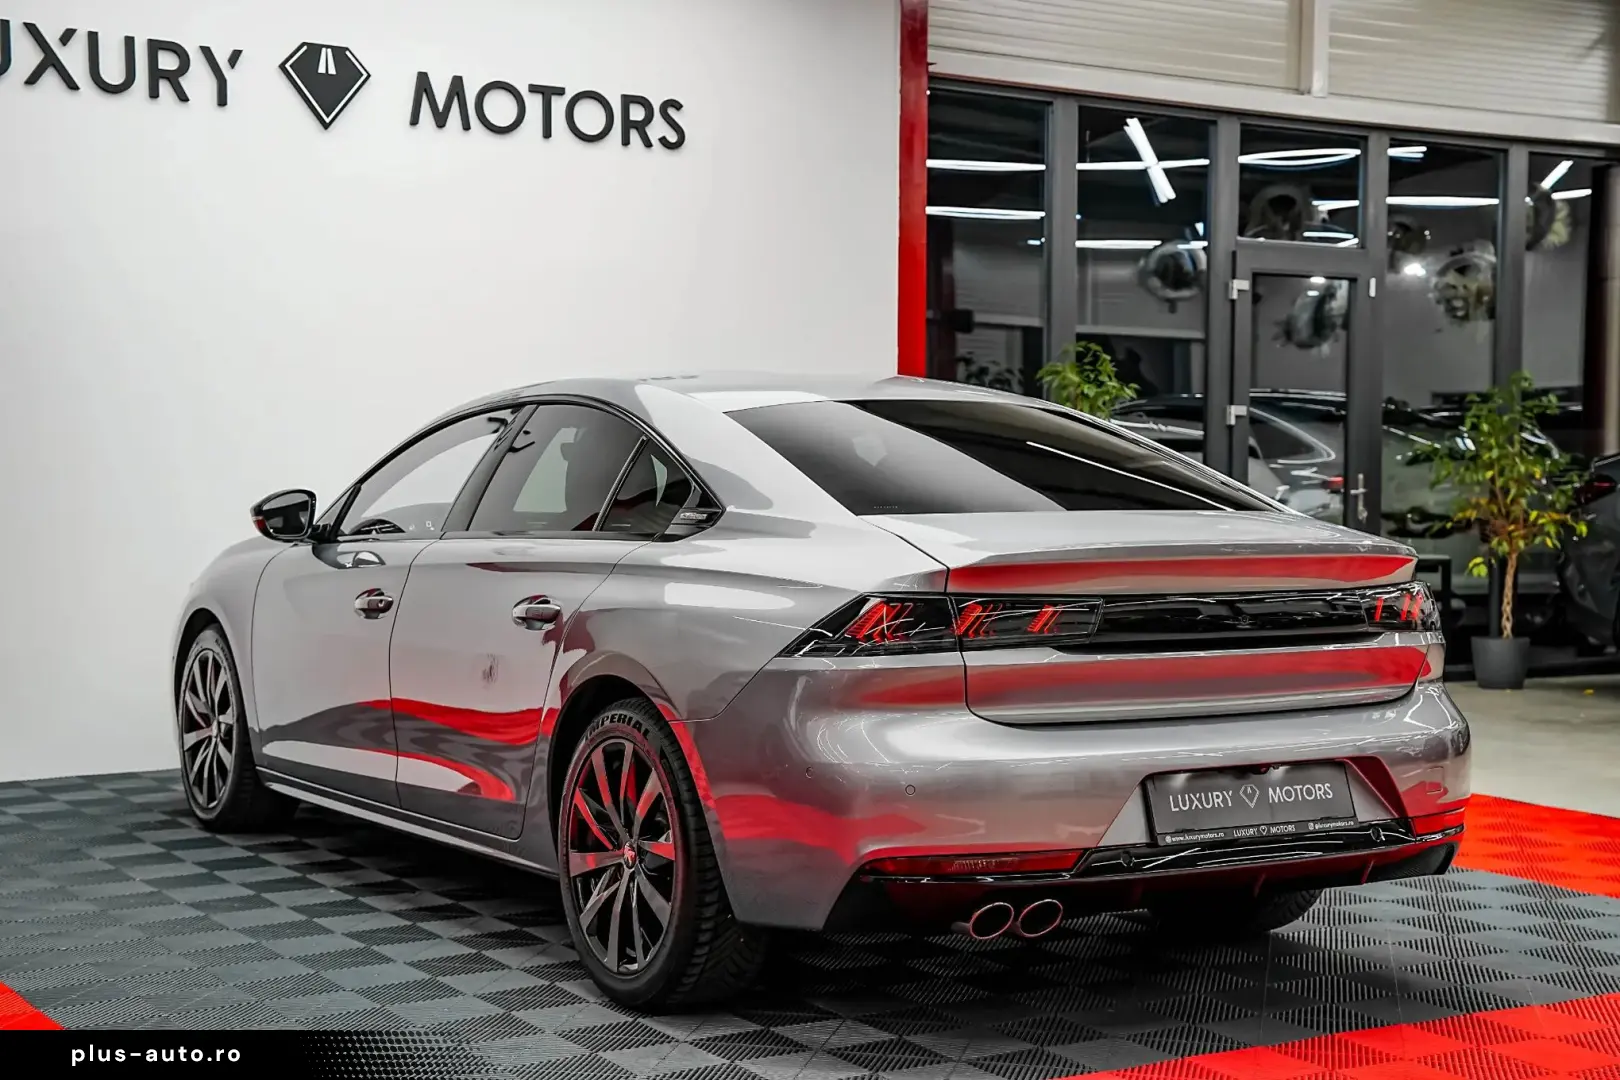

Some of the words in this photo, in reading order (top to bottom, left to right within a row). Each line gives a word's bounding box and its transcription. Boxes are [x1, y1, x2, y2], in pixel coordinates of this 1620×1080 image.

[0, 19, 243, 107] XURY
[409, 71, 686, 150] MOTORS
[1169, 790, 1233, 812] LUXURY
[1268, 783, 1334, 804] MOTORS
[1233, 827, 1258, 838] LUXURY
[1270, 824, 1296, 834] MOTORS
